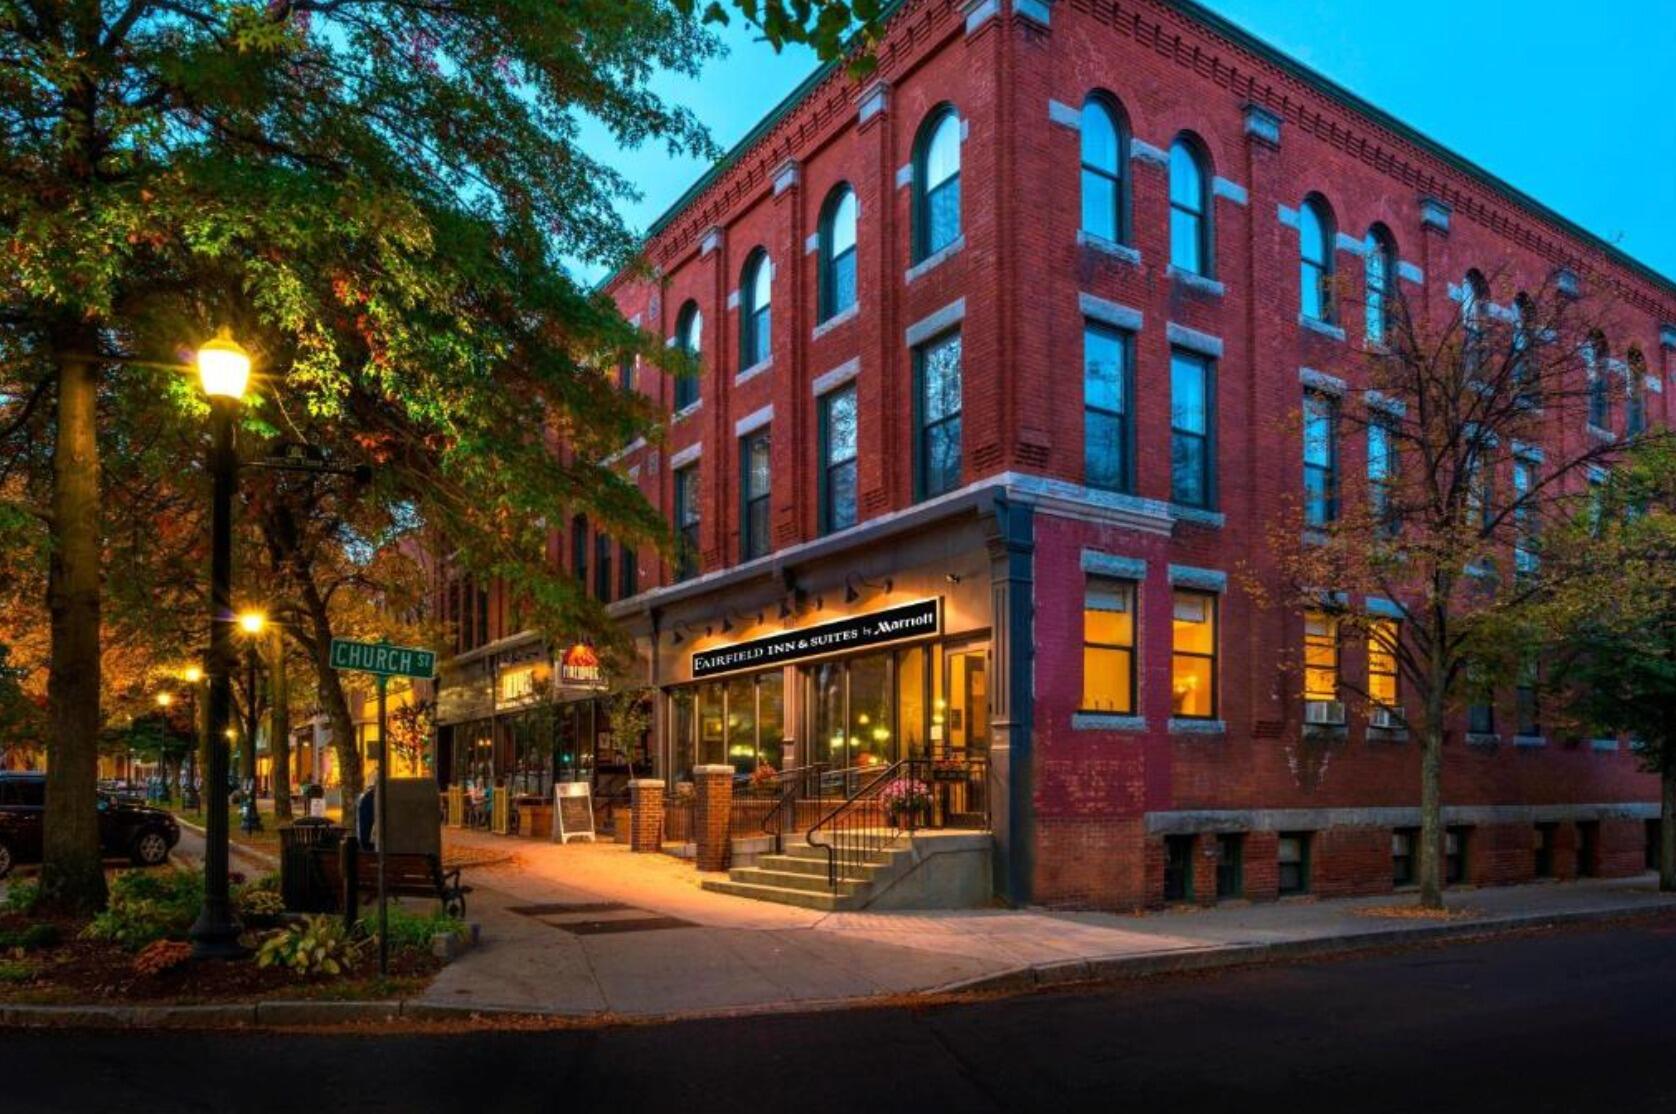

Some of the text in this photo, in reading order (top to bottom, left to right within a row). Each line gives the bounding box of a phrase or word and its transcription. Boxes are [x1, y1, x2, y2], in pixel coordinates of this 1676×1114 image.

[336, 644, 430, 672] CHURCH ST
[694, 612, 933, 670] FAIRFIELD INN & SUITES by Marriott
